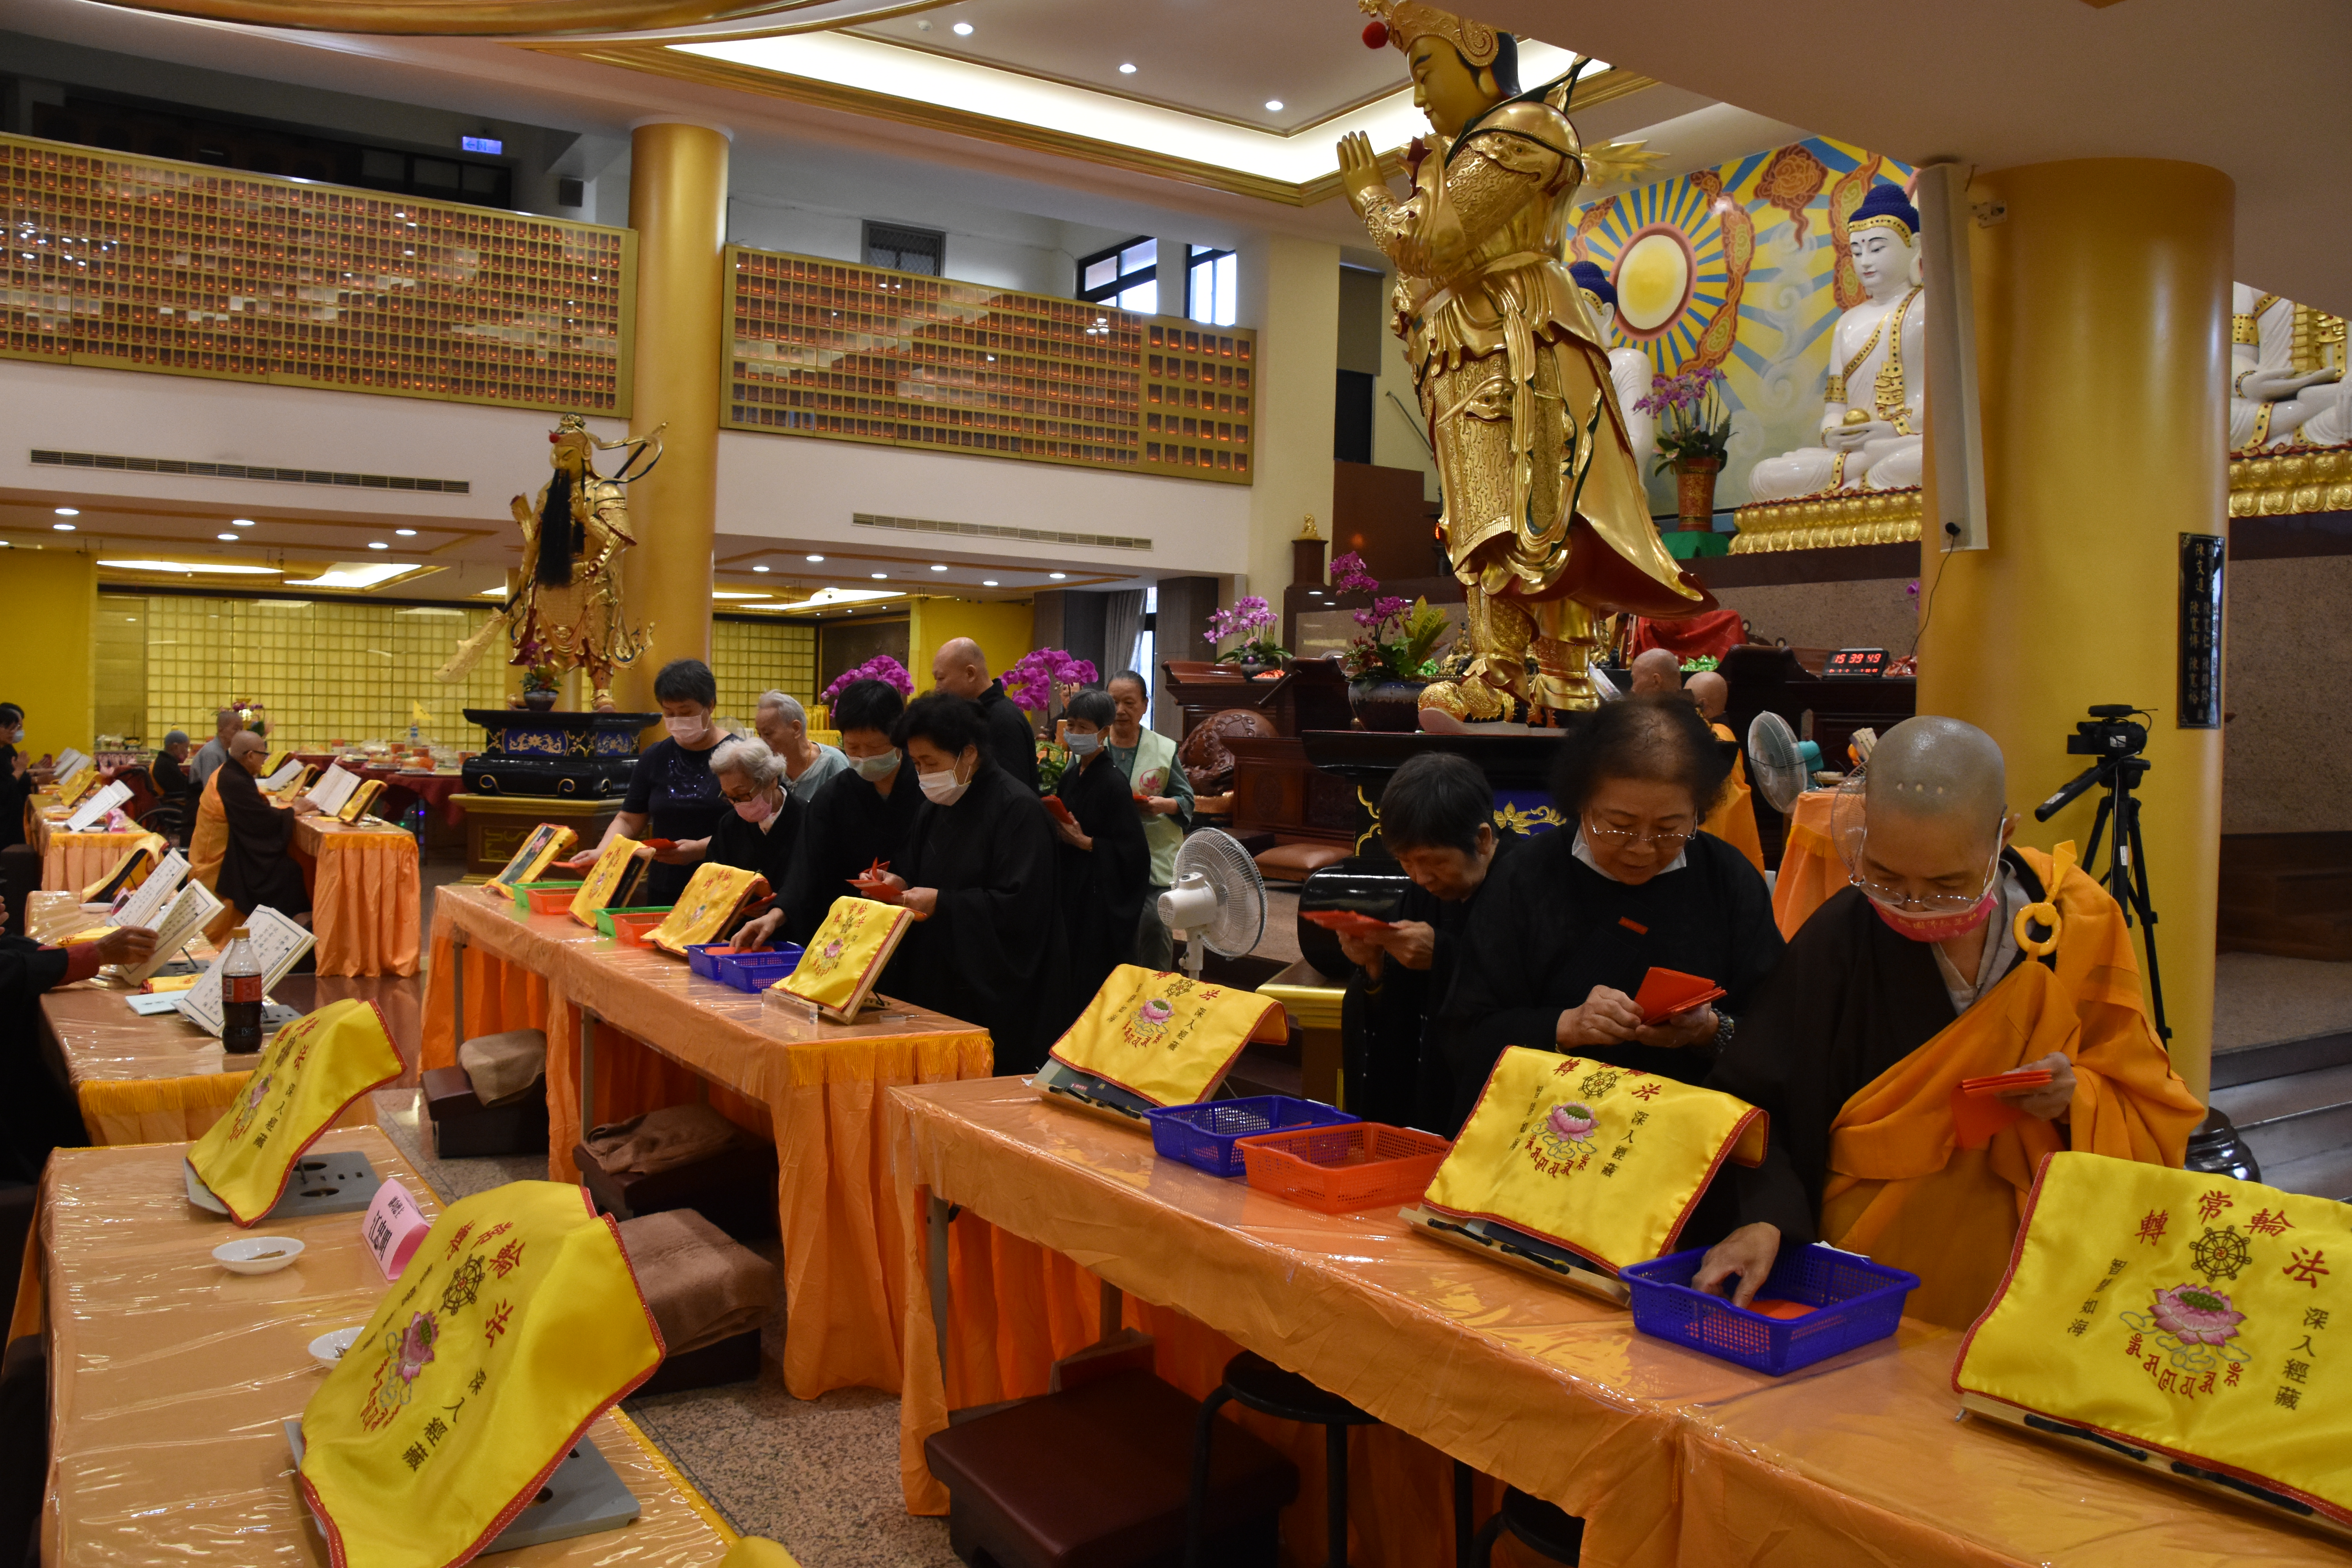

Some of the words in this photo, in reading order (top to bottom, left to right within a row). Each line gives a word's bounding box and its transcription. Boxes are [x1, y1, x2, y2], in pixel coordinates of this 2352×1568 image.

[1849, 653, 1864, 663] 39
[1867, 653, 1882, 663] 49
[1601, 1110, 1649, 1178] 深入經藏
[2134, 1190, 2330, 1289] 法輪常轉
[2275, 1307, 2329, 1410] 深入經藏
